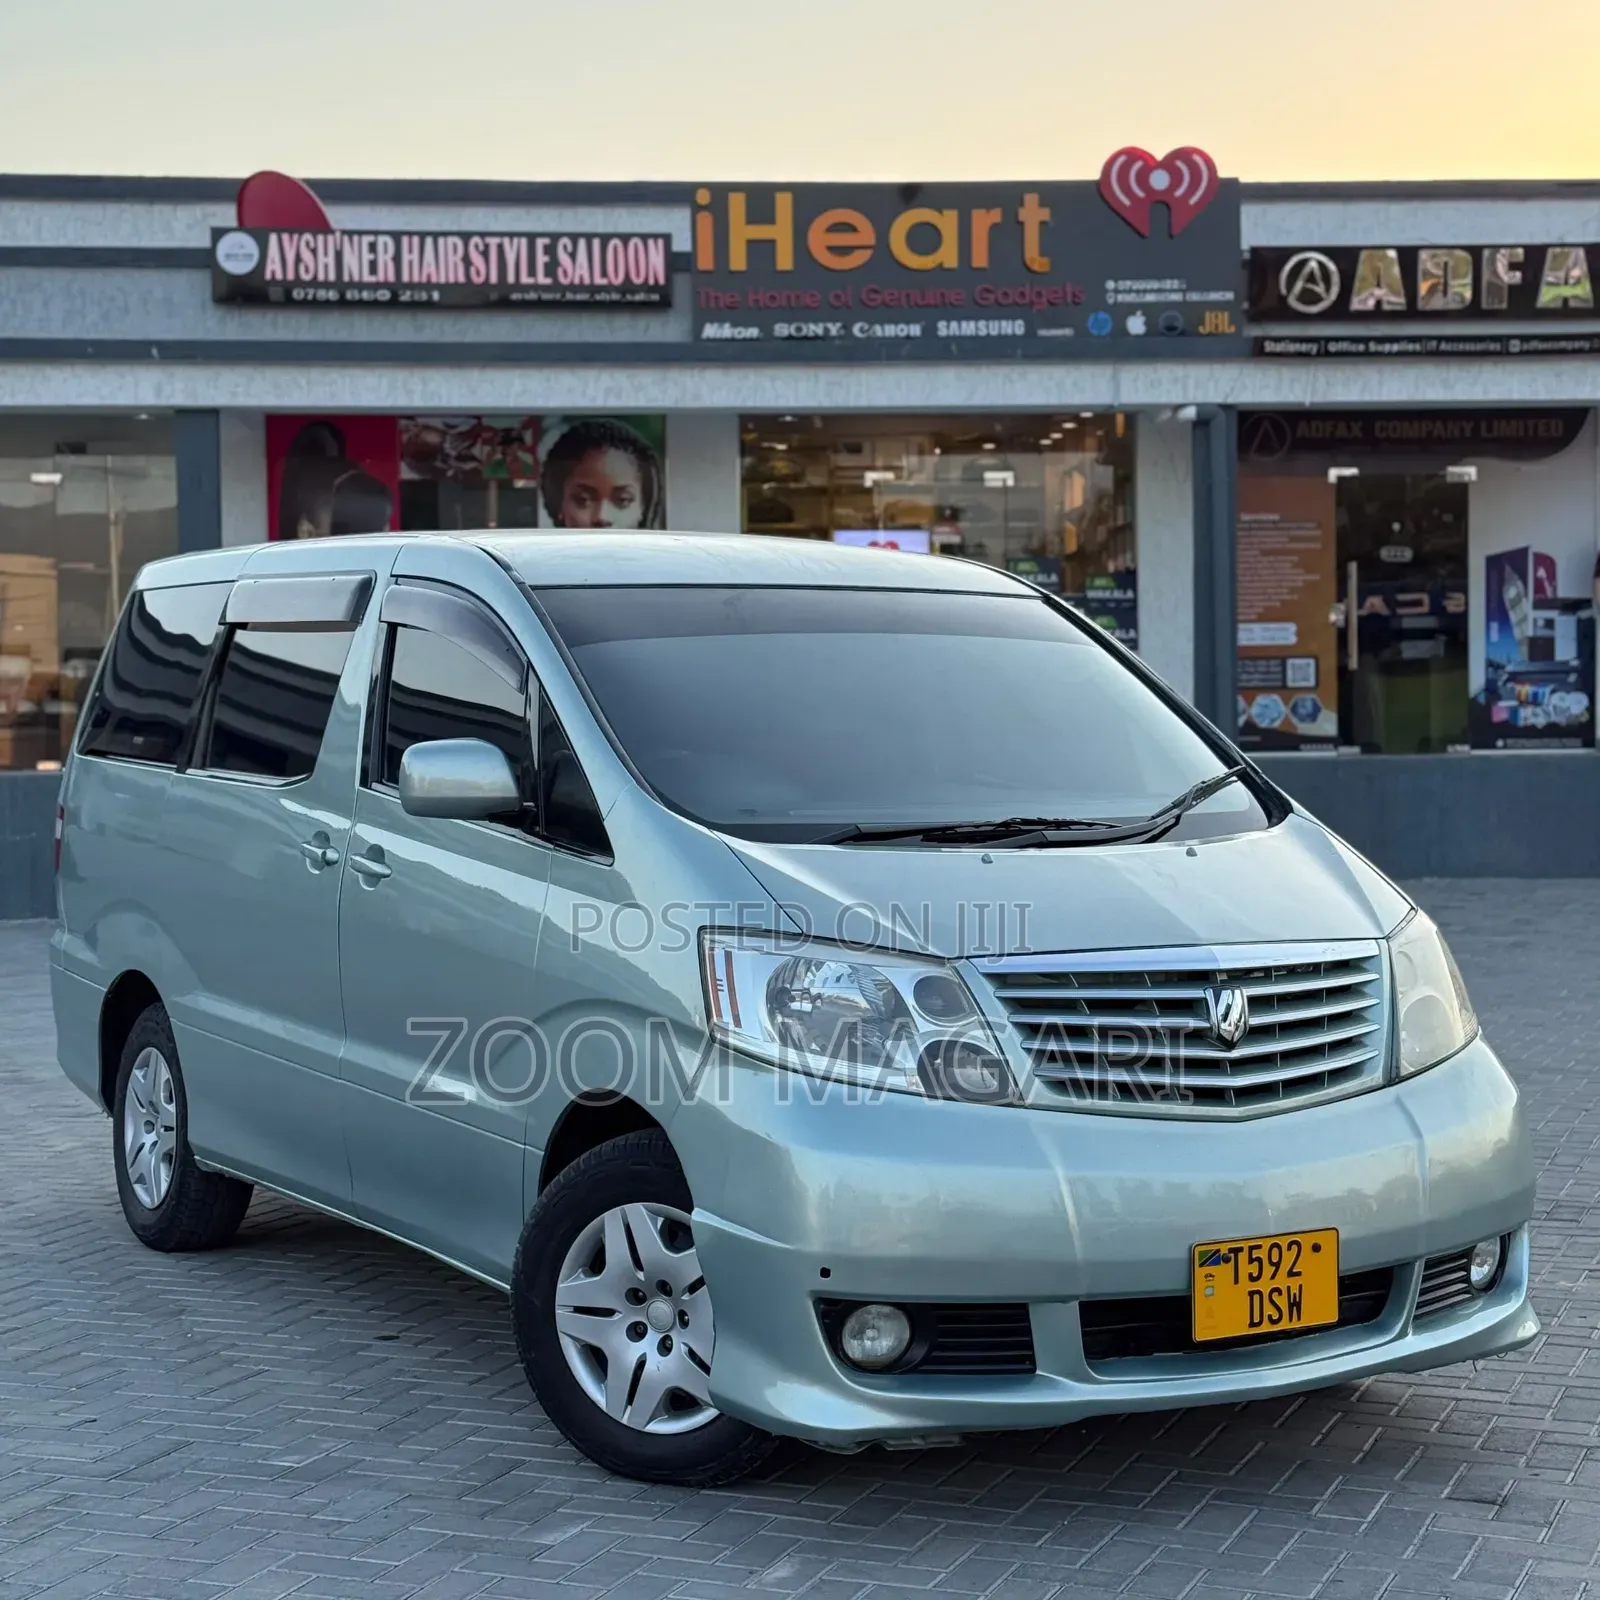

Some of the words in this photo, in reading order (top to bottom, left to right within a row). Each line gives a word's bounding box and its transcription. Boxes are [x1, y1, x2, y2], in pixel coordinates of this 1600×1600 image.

[696, 189, 1051, 273] iHeart
[264, 231, 397, 284] AYSH'NER
[556, 236, 667, 287] SALOON
[697, 287, 741, 310] The
[748, 286, 822, 309] Home
[829, 283, 853, 308] of
[859, 283, 967, 308] Genuine
[973, 281, 1086, 312] Gadgets
[701, 322, 761, 340] Nikon
[773, 321, 844, 338] SONY
[852, 321, 924, 338] Canon
[937, 320, 1026, 338] SAMSUNG
[1198, 311, 1236, 334] JBL
[1263, 339, 1319, 356] Stationery
[1327, 339, 1366, 353] Office
[1368, 339, 1421, 354] Supplies
[1296, 420, 1363, 439] ADFAX
[1374, 420, 1474, 438] COMPANY
[1480, 418, 1563, 438] LIMITED
[1227, 1239, 1303, 1285] T592
[1248, 1284, 1303, 1329] DSW
